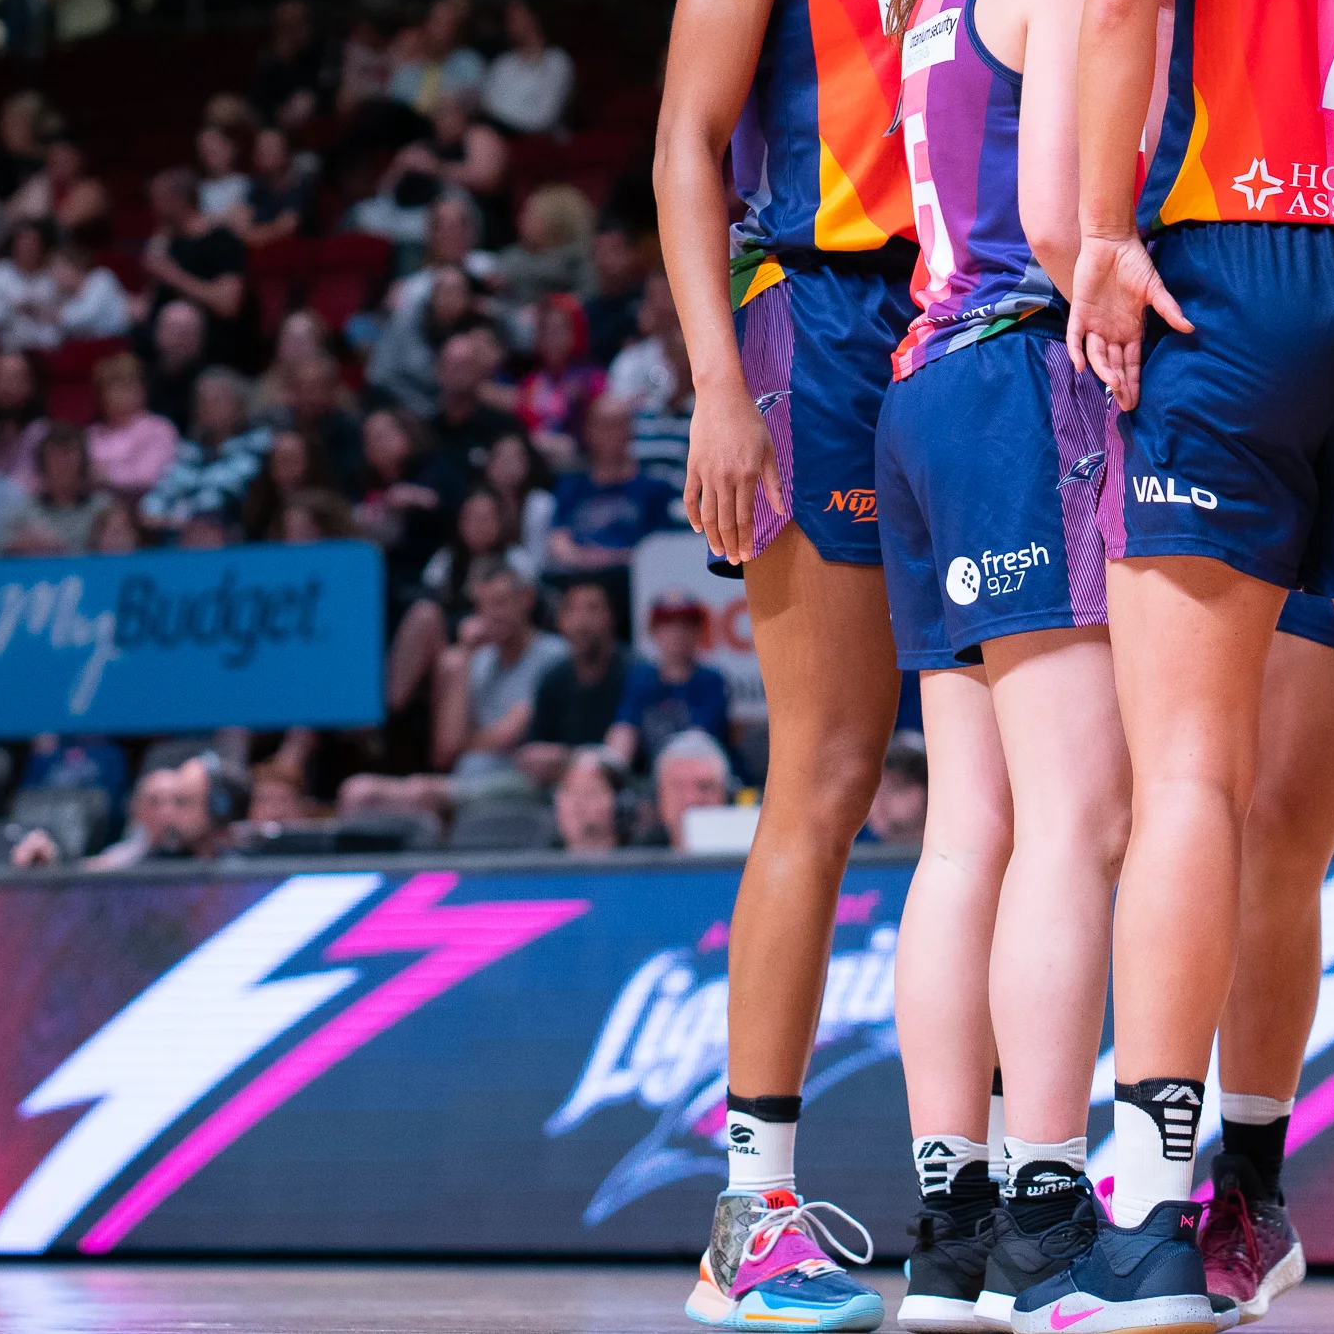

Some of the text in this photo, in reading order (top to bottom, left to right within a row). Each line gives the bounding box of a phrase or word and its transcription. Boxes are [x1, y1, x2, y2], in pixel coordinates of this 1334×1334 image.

[1132, 476, 1218, 510] VALO
[980, 541, 1050, 577] fresh
[987, 570, 1027, 597] 92.7
